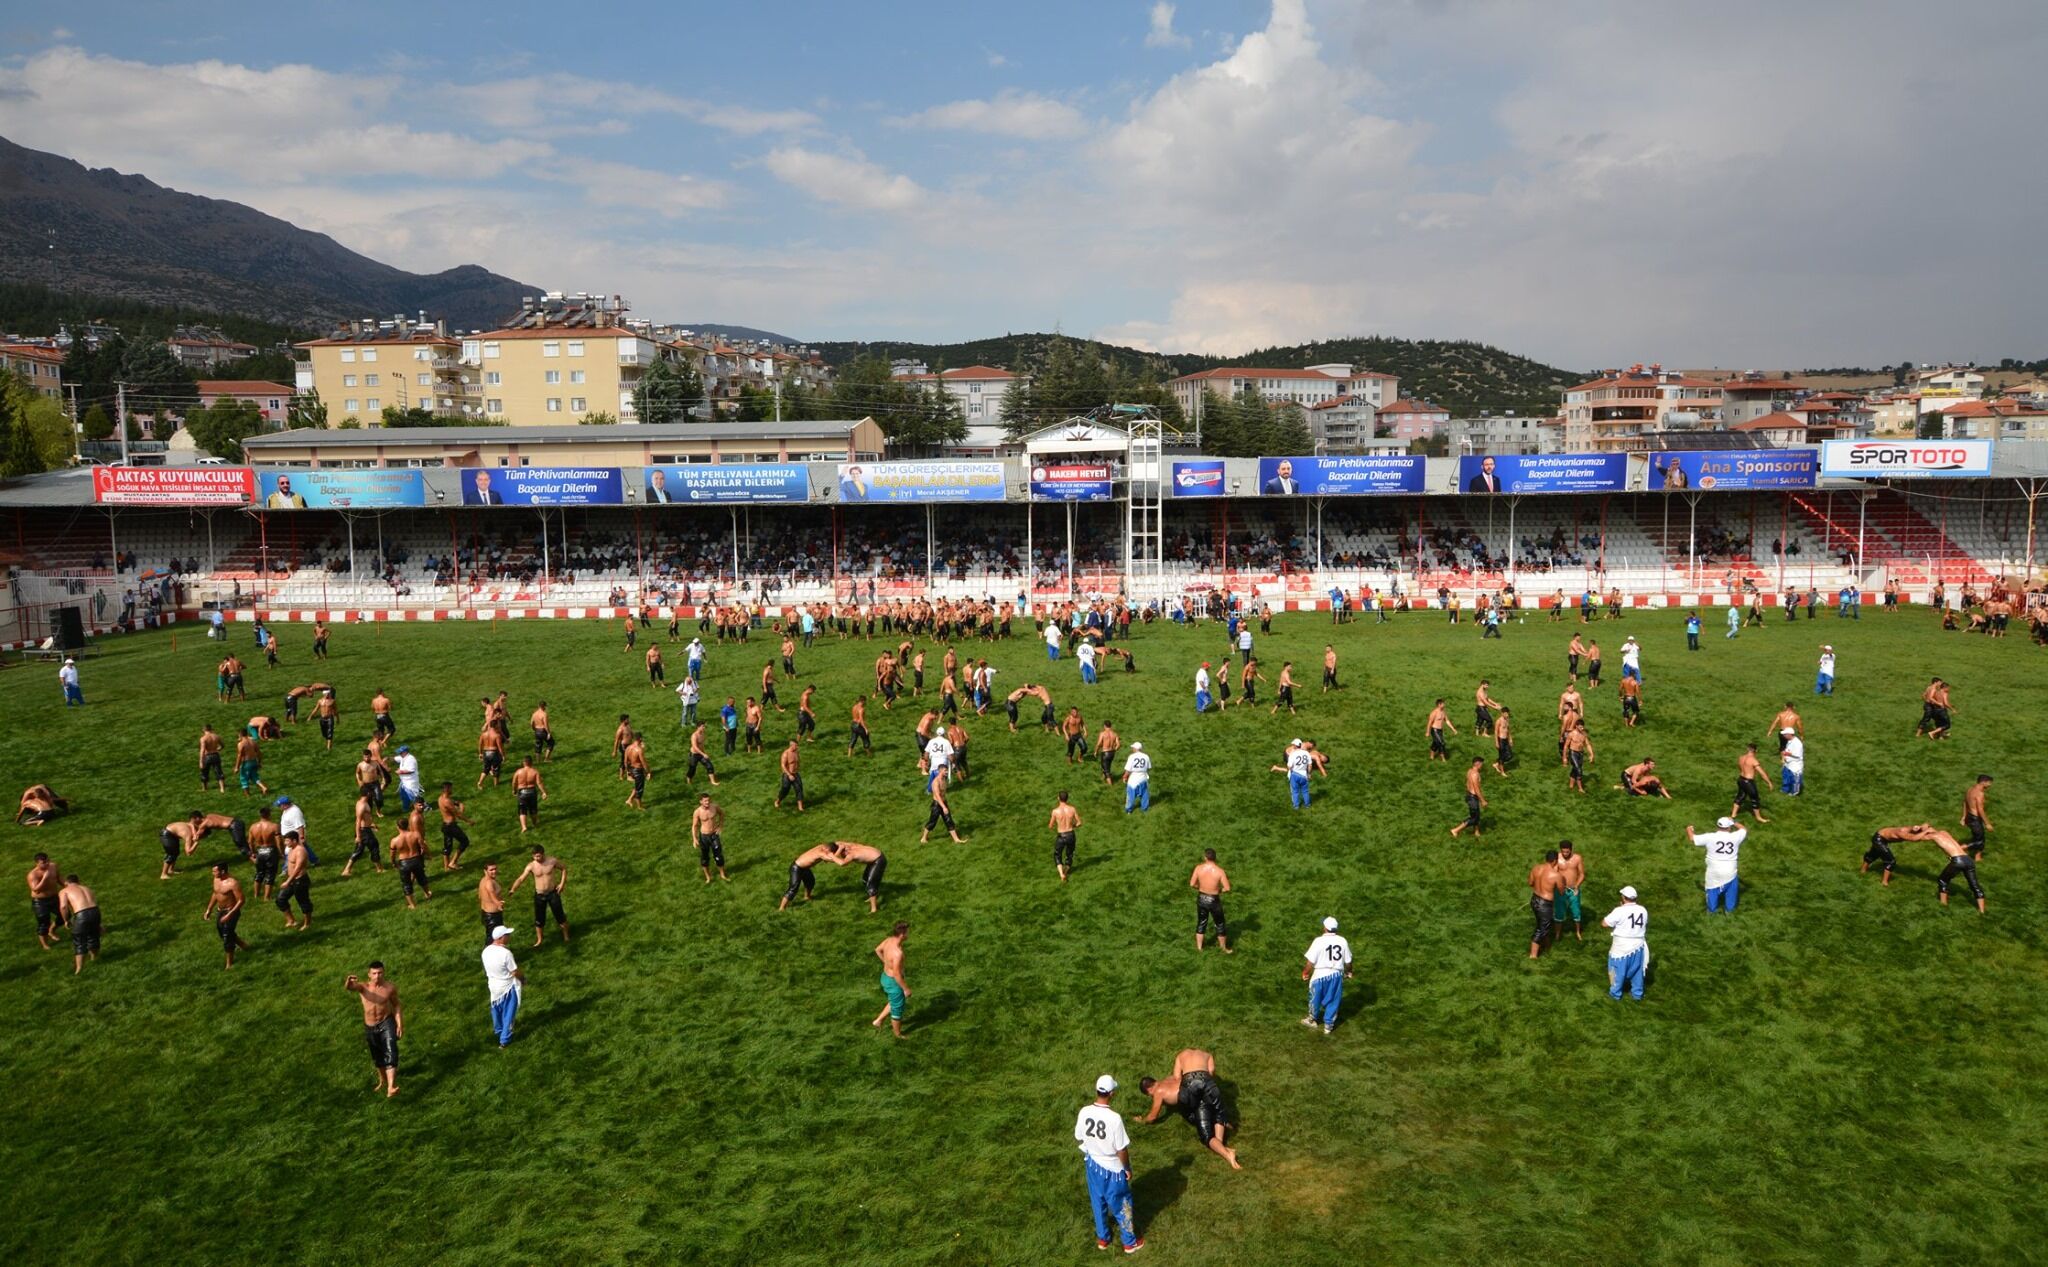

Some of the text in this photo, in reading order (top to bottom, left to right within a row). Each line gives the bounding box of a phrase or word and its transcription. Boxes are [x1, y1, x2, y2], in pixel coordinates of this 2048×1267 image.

[1317, 458, 1413, 468] Tüm Pehlivanlarımıza
[1519, 456, 1605, 467] Tüm Pehlivanlarımıza
[872, 463, 1000, 476] TÜM GÜREŞÇİLERİMİZE
[1049, 467, 1107, 479] HAKEM HEYETİ
[1528, 468, 1595, 480] Başarılar Dilerim
[1701, 460, 1811, 476] Ana Sponsoru
[116, 471, 244, 484] AKTAŞ KUYUMCULUK
[307, 474, 328, 484] Tüm
[505, 469, 609, 480] Tüm Pehlivanlarımıza
[678, 469, 797, 480] TÜM PEHLİVANLARIMIZA
[1328, 470, 1402, 482] Başarılar Dilerim
[1779, 476, 1808, 485] SARICA
[687, 478, 785, 490] BAŞARILAR DİLERİM
[872, 474, 1001, 488] BAŞARILAR DİLERİM
[193, 484, 216, 492] İNŞAAT
[518, 483, 597, 496] Başarılar Dilerim
[936, 489, 971, 497] AKŞENER
[932, 742, 944, 753] 34
[1133, 757, 1146, 769] 29
[1295, 754, 1308, 767] 28
[1716, 841, 1734, 855] 23
[1628, 913, 1644, 929] 14
[1326, 944, 1342, 961] 13
[1085, 1118, 1107, 1140] 28
